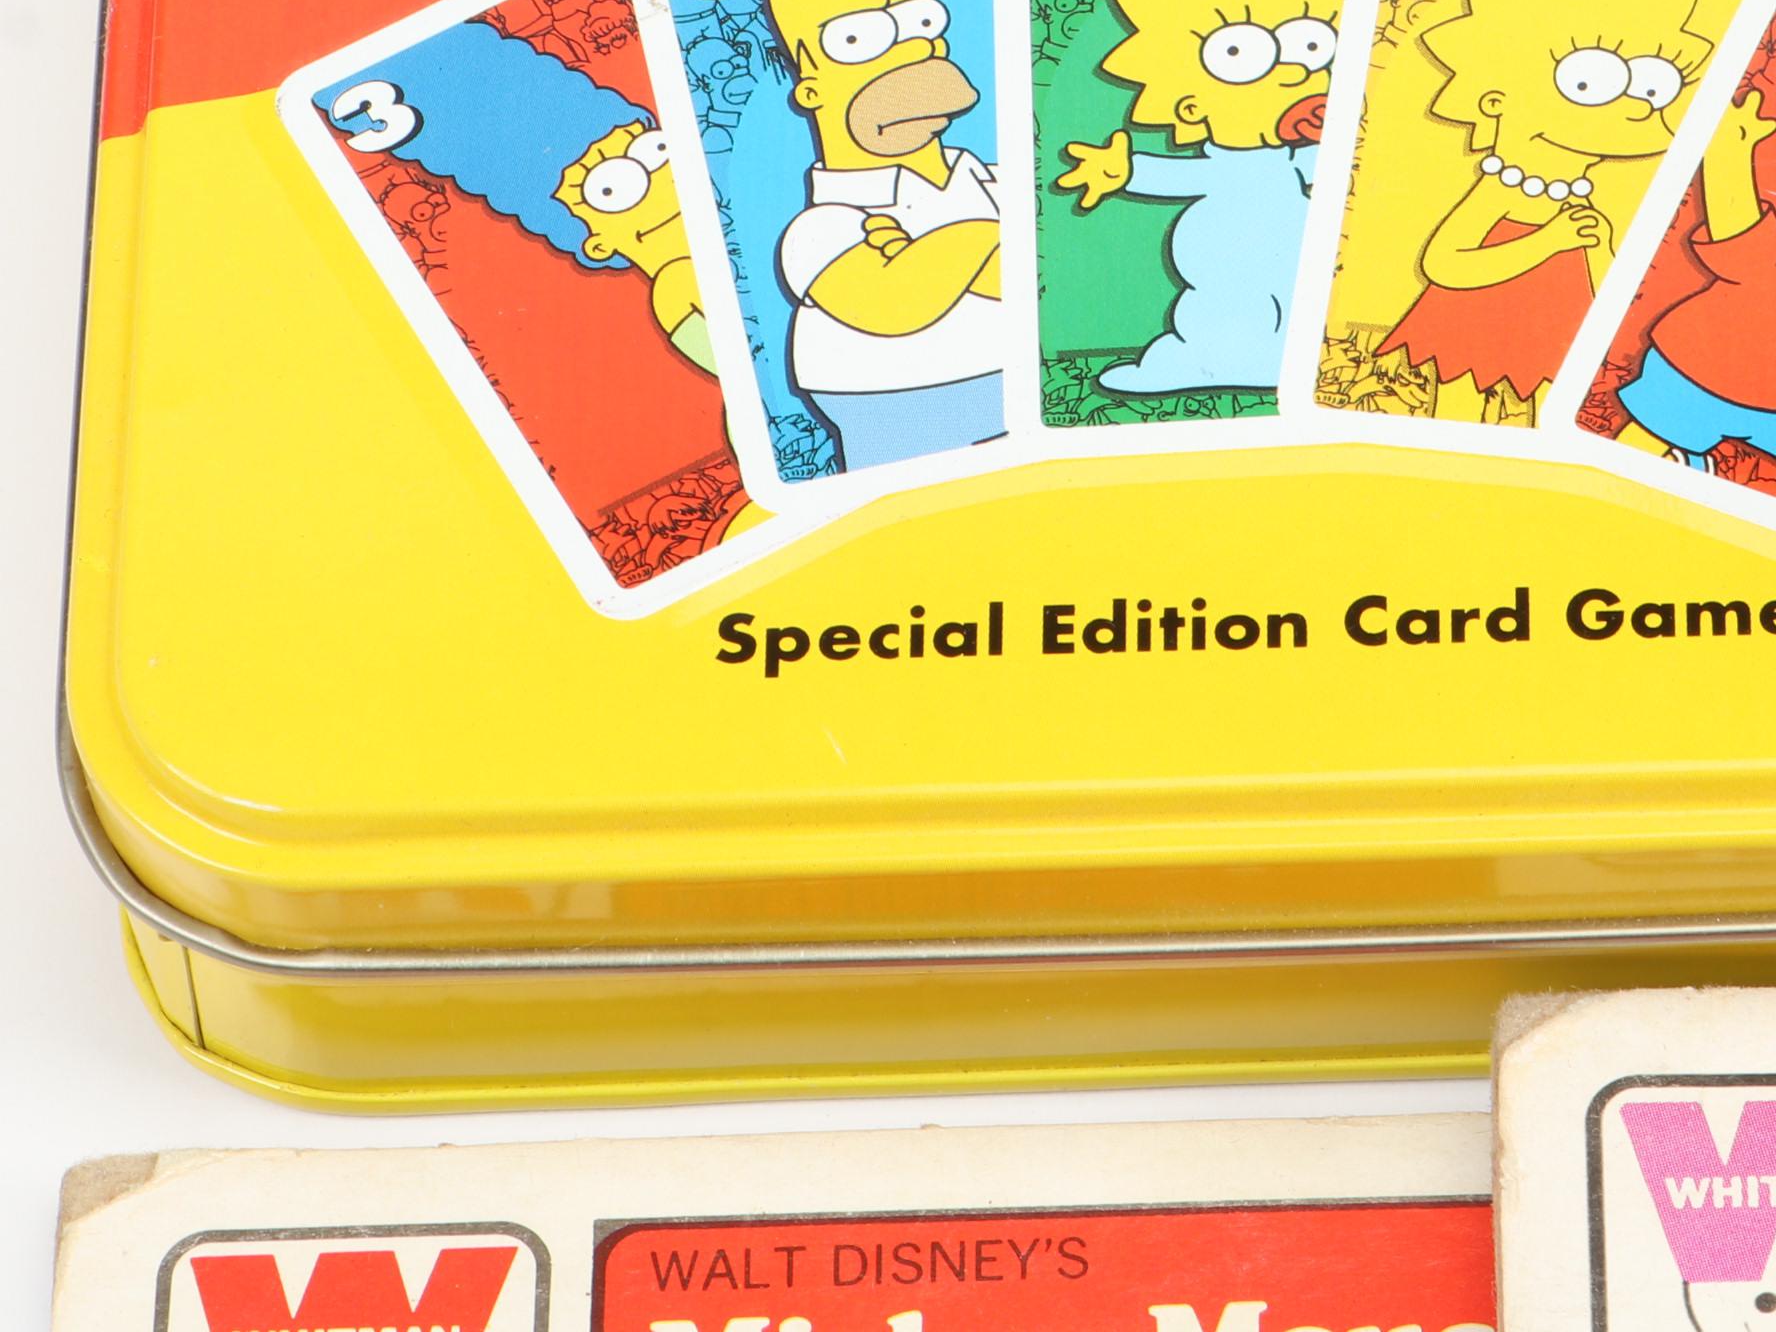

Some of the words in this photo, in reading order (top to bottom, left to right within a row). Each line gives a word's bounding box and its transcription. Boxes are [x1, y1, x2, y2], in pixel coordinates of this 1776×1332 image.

[330, 78, 424, 154] 3
[715, 599, 1004, 680] Special
[1041, 597, 1308, 656] Edition
[1344, 586, 1533, 649] Card
[650, 1245, 806, 1293] WALT
[832, 1237, 1090, 1287] DISNEY'S
